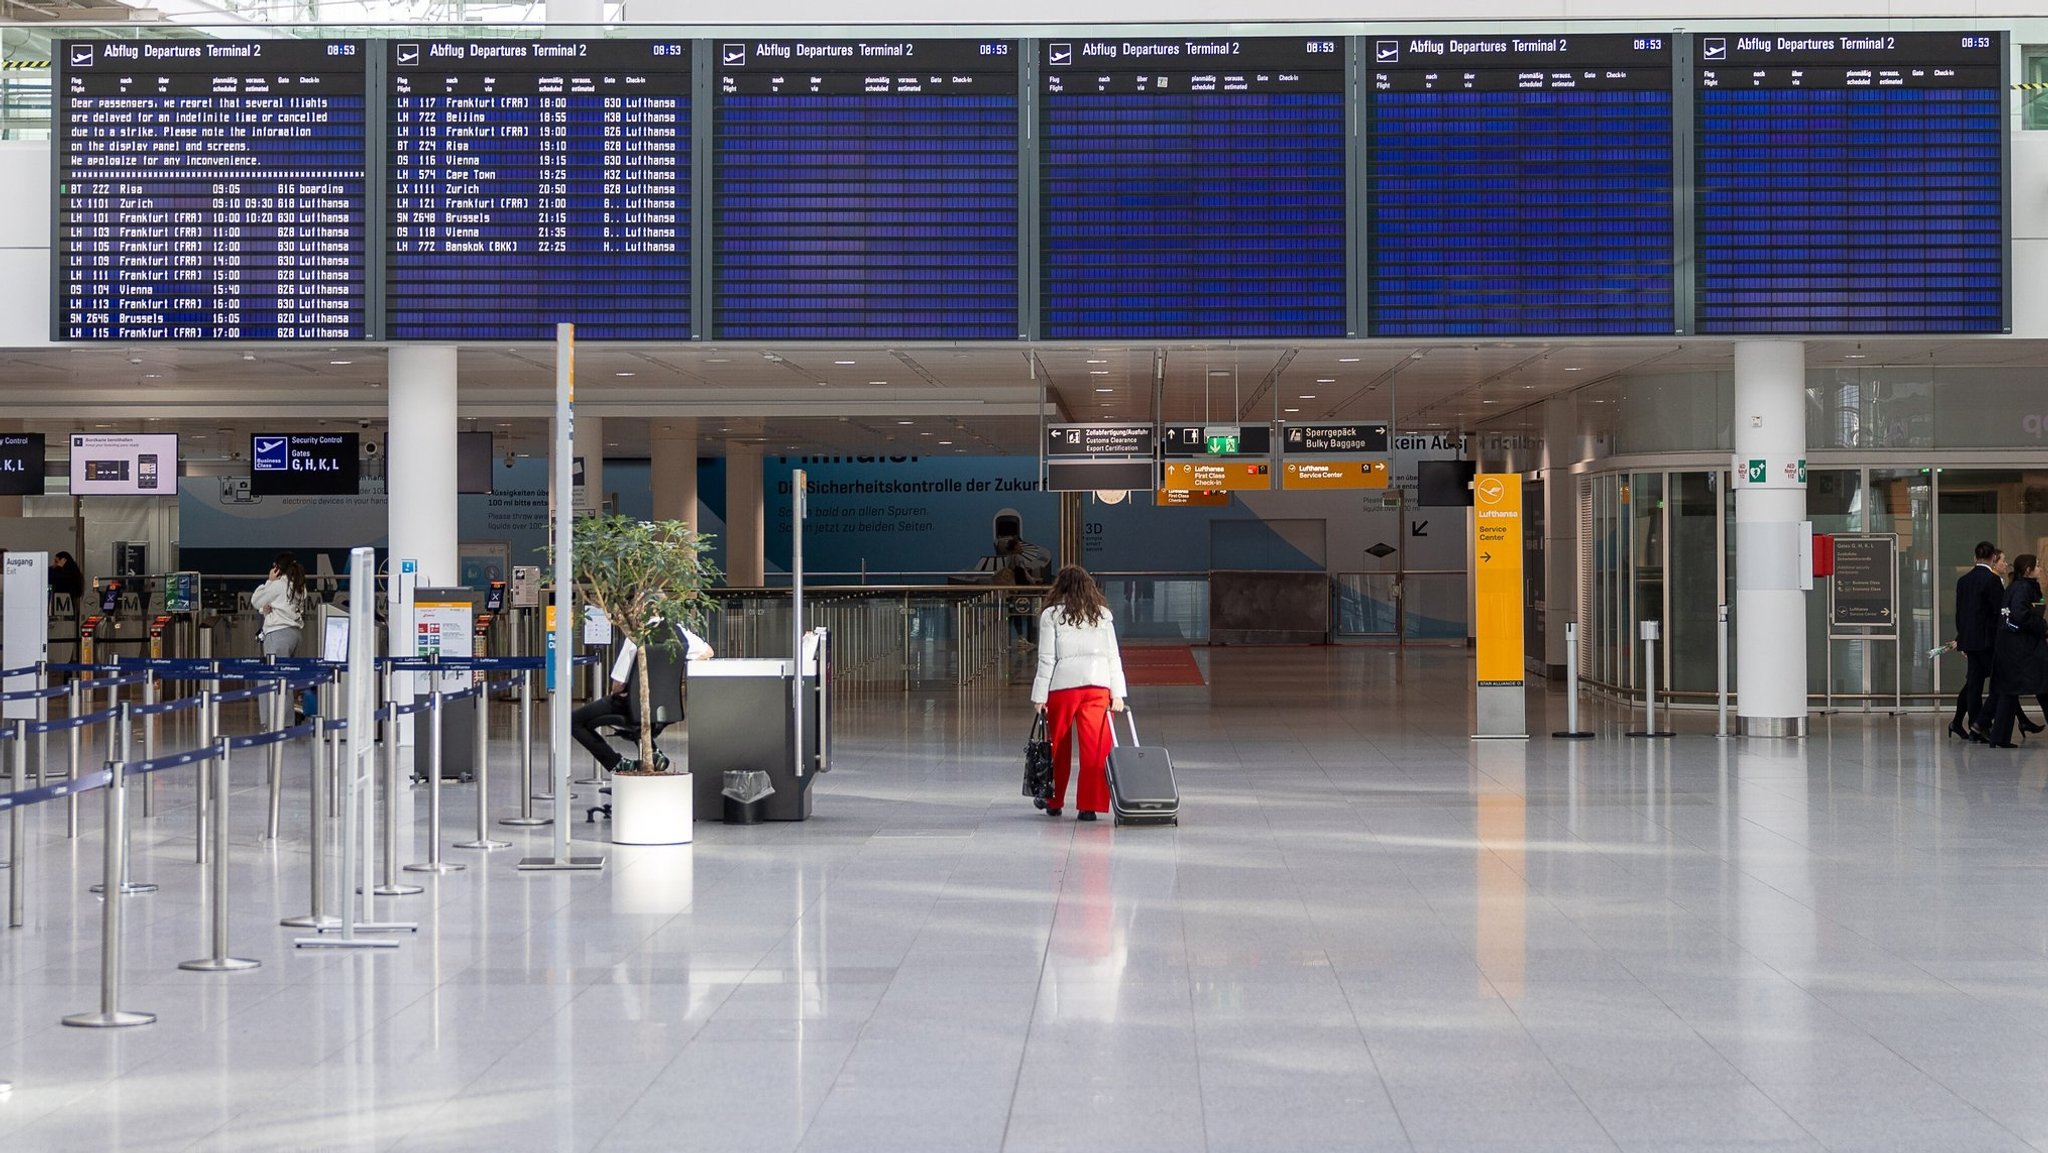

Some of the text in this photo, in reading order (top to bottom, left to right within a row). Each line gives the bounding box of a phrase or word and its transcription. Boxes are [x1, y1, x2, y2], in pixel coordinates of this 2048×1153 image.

[1307, 42, 1334, 52] 08:53
[1410, 39, 1566, 55] Abflug Departures Terminal 2
[1634, 40, 1661, 49] 08:53
[1737, 37, 1894, 52] Abflug Departures Terminal 2
[1962, 38, 1989, 47] 08:53
[104, 44, 261, 59] Abflug Departures Terminal 2
[328, 45, 355, 55] 08:53
[430, 44, 586, 58] Abflug Departures Terminal 2
[654, 45, 681, 55] 08:53
[756, 44, 913, 58] Abflug Departures Terminal 2
[980, 45, 1007, 54] 08:53
[1083, 42, 1239, 57] Abflug Departures Terminal 2
[72, 98, 93, 108] Dear
[99, 100, 157, 108] passengers,
[181, 98, 212, 108] regret
[220, 98, 239, 108] that
[246, 98, 282, 107] several
[291, 98, 327, 107] flights
[72, 112, 327, 122] are delayed for an indefinite time or cancelled
[398, 112, 675, 122] LH 722 Beijing 18:55 H38 Lufthansa
[72, 127, 88, 136] due
[94, 127, 104, 136] to
[121, 127, 157, 136] strike.
[164, 127, 196, 136] Please
[202, 127, 224, 136] note
[231, 127, 245, 136] the
[252, 127, 311, 136] information
[71, 141, 249, 151] on the display panel and screens.
[71, 156, 82, 165] We
[88, 156, 136, 165] apologize
[144, 156, 158, 165] for
[187, 156, 260, 165] inconvenience.
[398, 170, 675, 179] LH 574 Cape Town 19:25 H32 Lufthansa
[71, 184, 343, 194] BT 222 Riga 09:05 boarding
[1306, 428, 1356, 438] Sperrgepäck
[292, 436, 318, 444] Security
[1307, 439, 1366, 450] Bulky Baggage
[1390, 436, 1426, 450] kein
[5, 460, 24, 472] K, L
[292, 459, 339, 471] G, H, K, L
[1194, 465, 1224, 473] Lufthansa
[778, 478, 991, 494] Di Sicherheitskontrolle der
[488, 499, 531, 507] 100 ml bitte
[815, 506, 839, 517] bald
[858, 506, 885, 517] allen
[888, 506, 928, 519] Spuren.
[488, 522, 511, 531] liquids
[814, 521, 934, 535] jetzt zu beiden Seiten.
[1086, 523, 1102, 534] 3D
[7, 558, 33, 568] Ausgang
[7, 567, 17, 575] Exit
